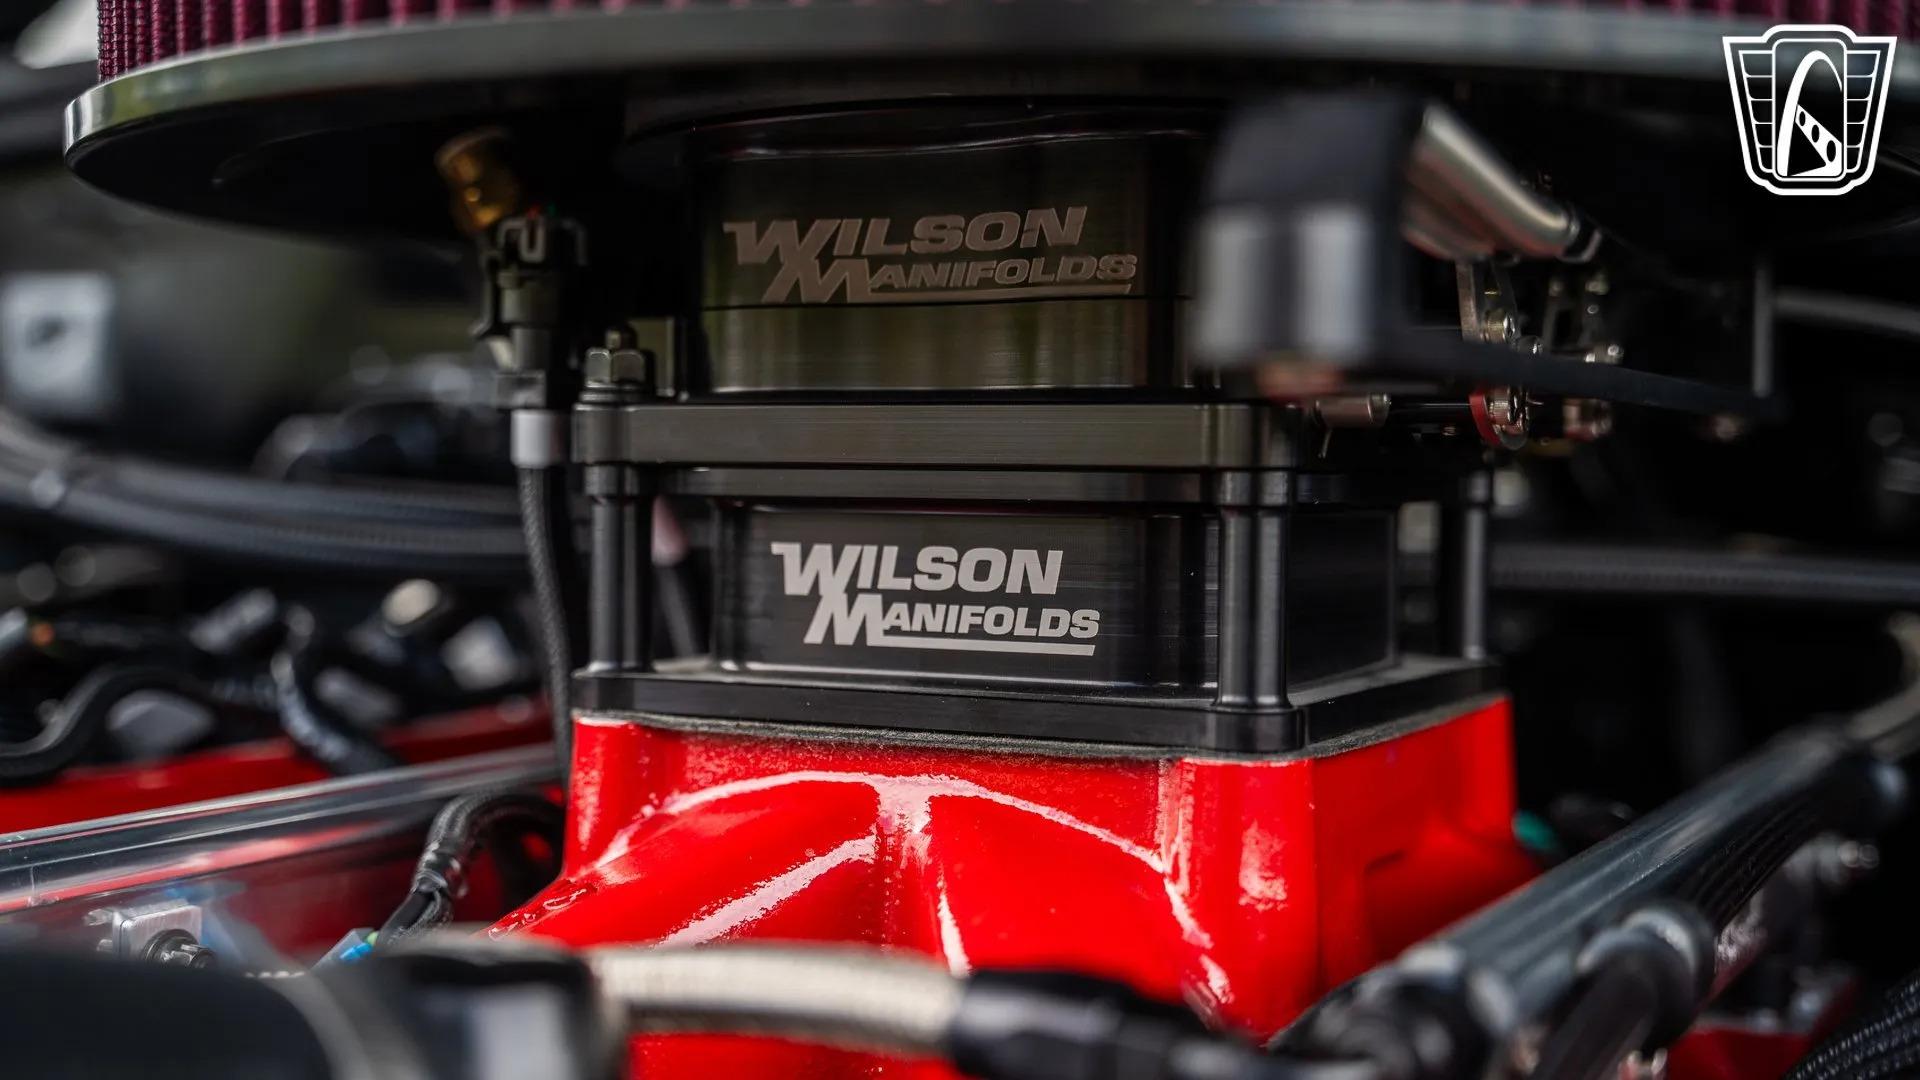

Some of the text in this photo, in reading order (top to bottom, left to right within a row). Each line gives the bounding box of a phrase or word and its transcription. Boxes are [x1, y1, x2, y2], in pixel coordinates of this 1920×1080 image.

[723, 206, 1088, 265] WILSON
[761, 253, 1138, 303] MANIFOLDS
[771, 542, 1064, 596] WILSON
[803, 592, 1100, 647] MANIFOLDS
